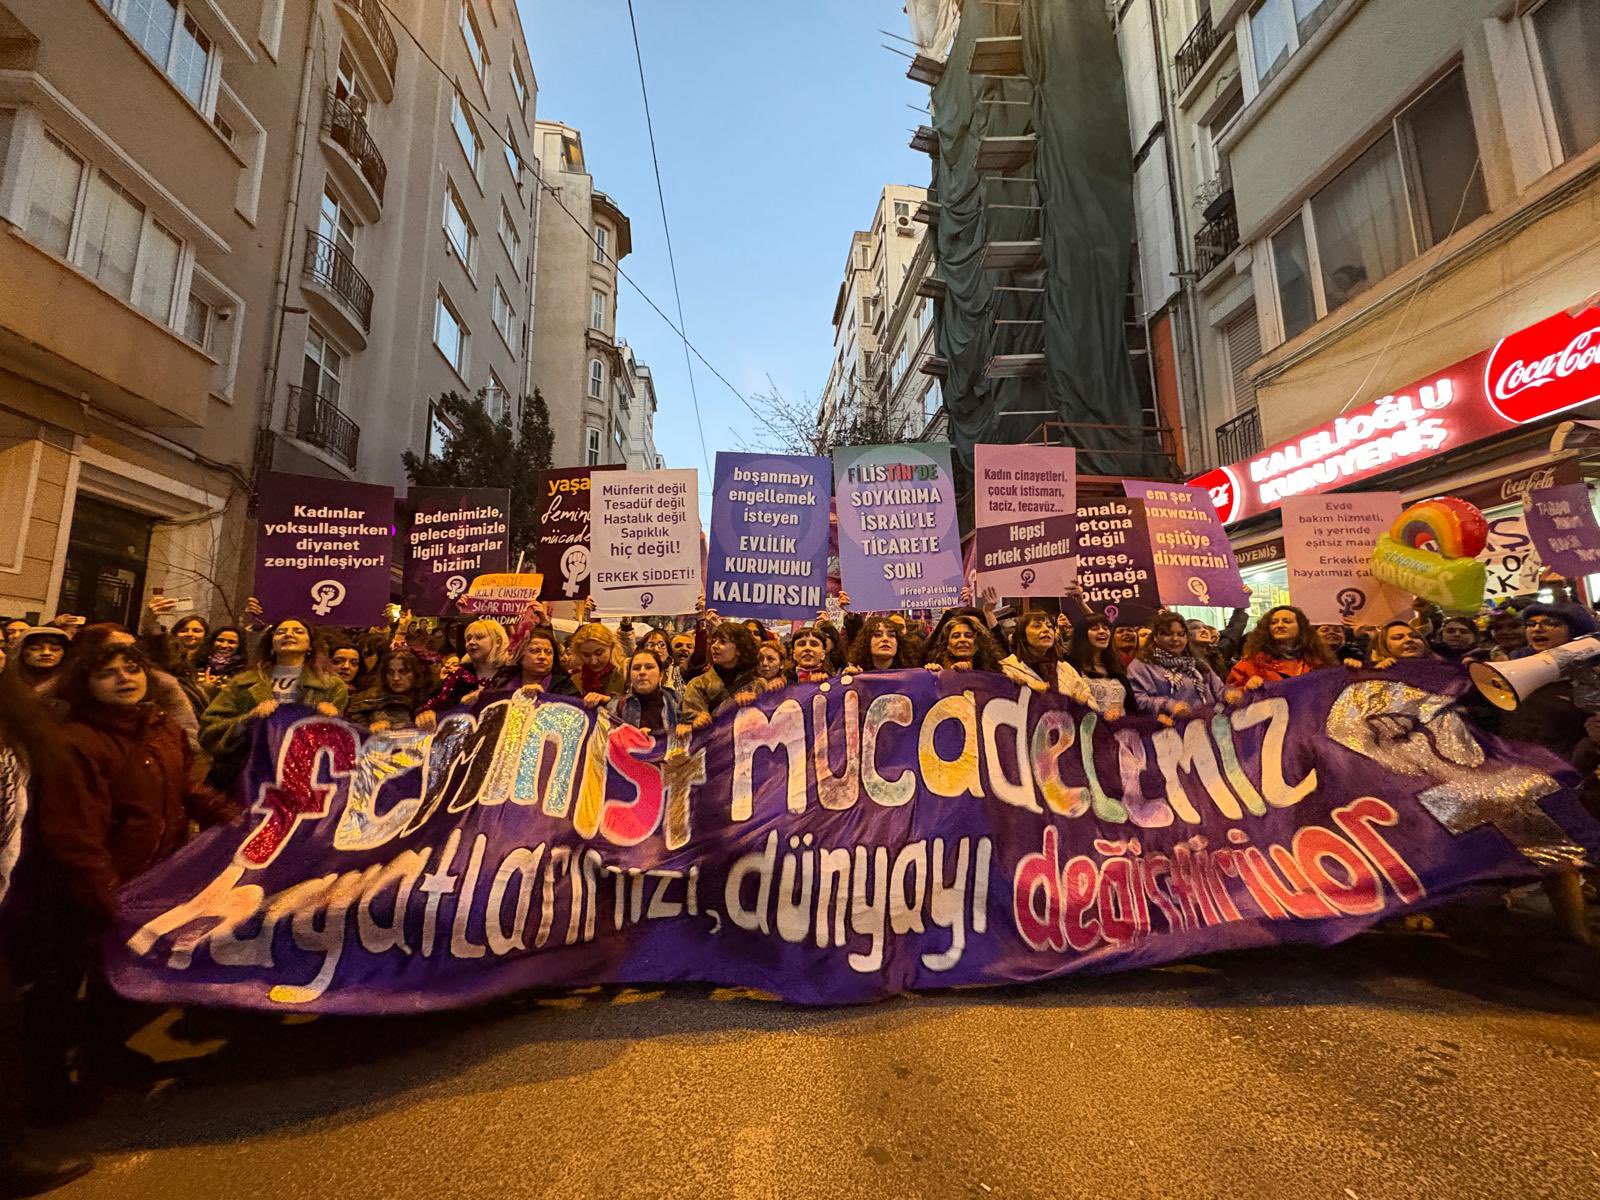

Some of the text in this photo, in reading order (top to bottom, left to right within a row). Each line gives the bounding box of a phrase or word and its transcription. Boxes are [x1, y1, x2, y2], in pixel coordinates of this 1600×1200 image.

[734, 467, 814, 487] boşanmayı
[984, 468, 1011, 480] Kadın
[603, 483, 687, 496] Münferit değil
[729, 489, 816, 505] engellemek
[988, 485, 1065, 498] çocuk istismarı,
[604, 497, 685, 510] Tesadüf değil
[851, 488, 942, 507] SOYKIRIMA
[1146, 490, 1192, 505] em şer
[294, 505, 365, 520] Kadınlar
[989, 501, 1064, 513] taciz, tecavüz...
[1325, 502, 1353, 510] Evde
[414, 506, 503, 525] Bedenimizle,
[604, 512, 686, 524] Hastalık değil
[744, 508, 798, 527] isteyen
[1299, 514, 1384, 523] bakım hizmeti,
[264, 522, 388, 538] yoksullaşırken
[1010, 521, 1045, 541] Hepsi
[1076, 518, 1133, 532] etona
[1314, 526, 1371, 536] iş yerinde
[410, 522, 506, 545] geleceğimizle
[621, 527, 669, 540] Sapıklık
[1079, 531, 1125, 547] değil
[296, 538, 360, 553] diyanet
[412, 539, 503, 561] ilgili kararlar
[610, 541, 680, 559] hiç değil!
[740, 534, 797, 553] EVLİLİK
[862, 536, 940, 555] TİCARETE
[1305, 539, 1342, 549] eşitsiz
[984, 538, 1070, 567] erkek şiddeti!
[1153, 550, 1229, 568] dixwazin!
[1320, 556, 1372, 564] Erkekler
[264, 555, 385, 570] zenginleşiyor!
[432, 558, 481, 574] bizim!
[725, 557, 812, 577] KURUMUNU
[1076, 554, 1134, 568] kreşe,
[597, 567, 695, 583] ERKEK ŞİDDETİ!
[883, 562, 923, 580] SON!
[1294, 569, 1353, 578] hayatımızı
[713, 581, 821, 607] KALDIRSIN
[900, 585, 958, 596] #FreePalestine
[901, 596, 959, 608] #CeasefireNOW
[724, 829, 992, 974] dünyayı
